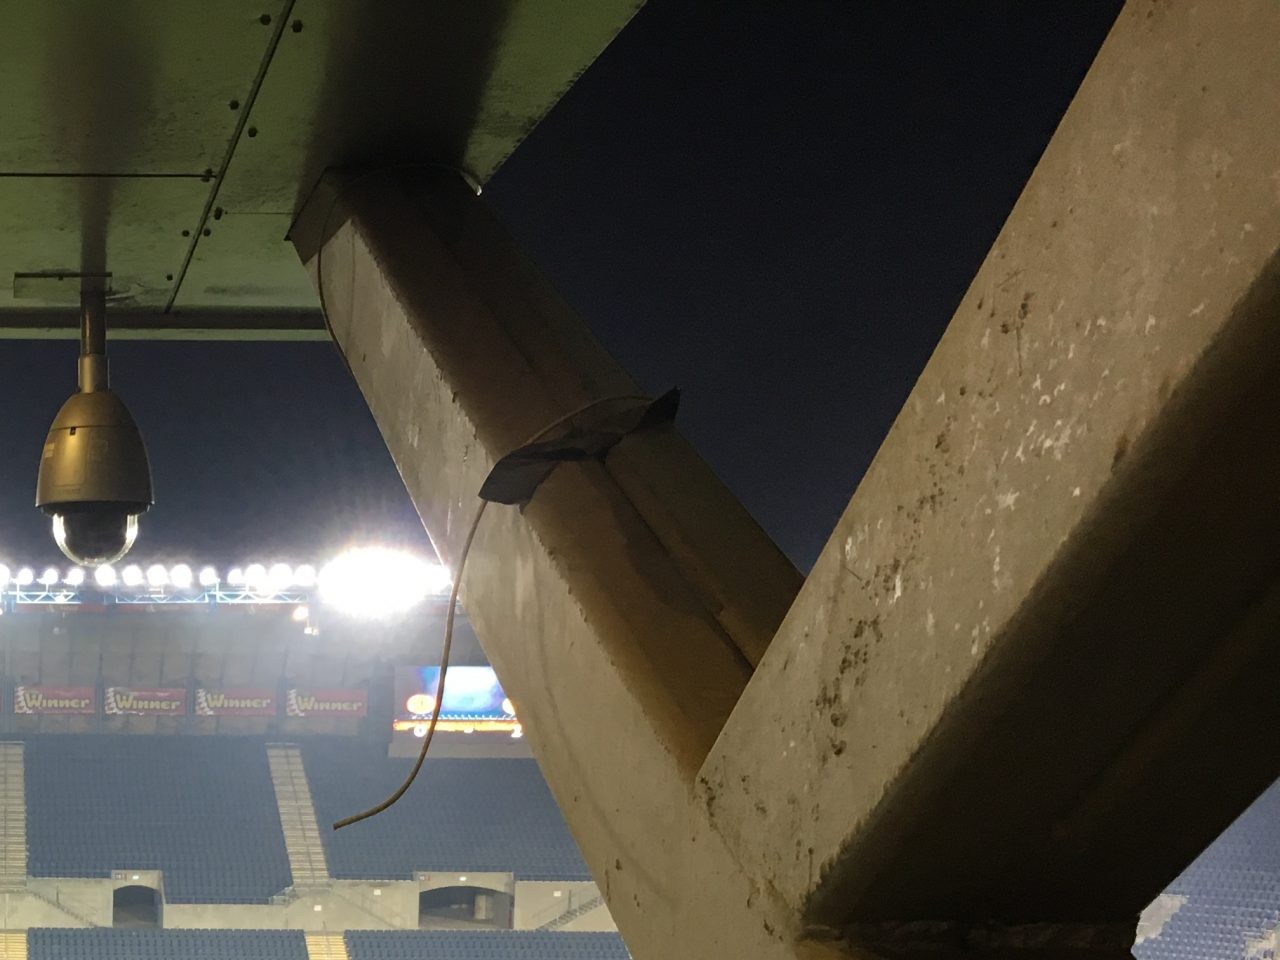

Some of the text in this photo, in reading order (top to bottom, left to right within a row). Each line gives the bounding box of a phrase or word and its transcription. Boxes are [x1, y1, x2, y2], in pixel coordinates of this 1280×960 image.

[24, 691, 90, 708] Winner
[116, 693, 182, 710] Winner
[207, 693, 271, 710] Winner
[296, 695, 363, 712] Winner
